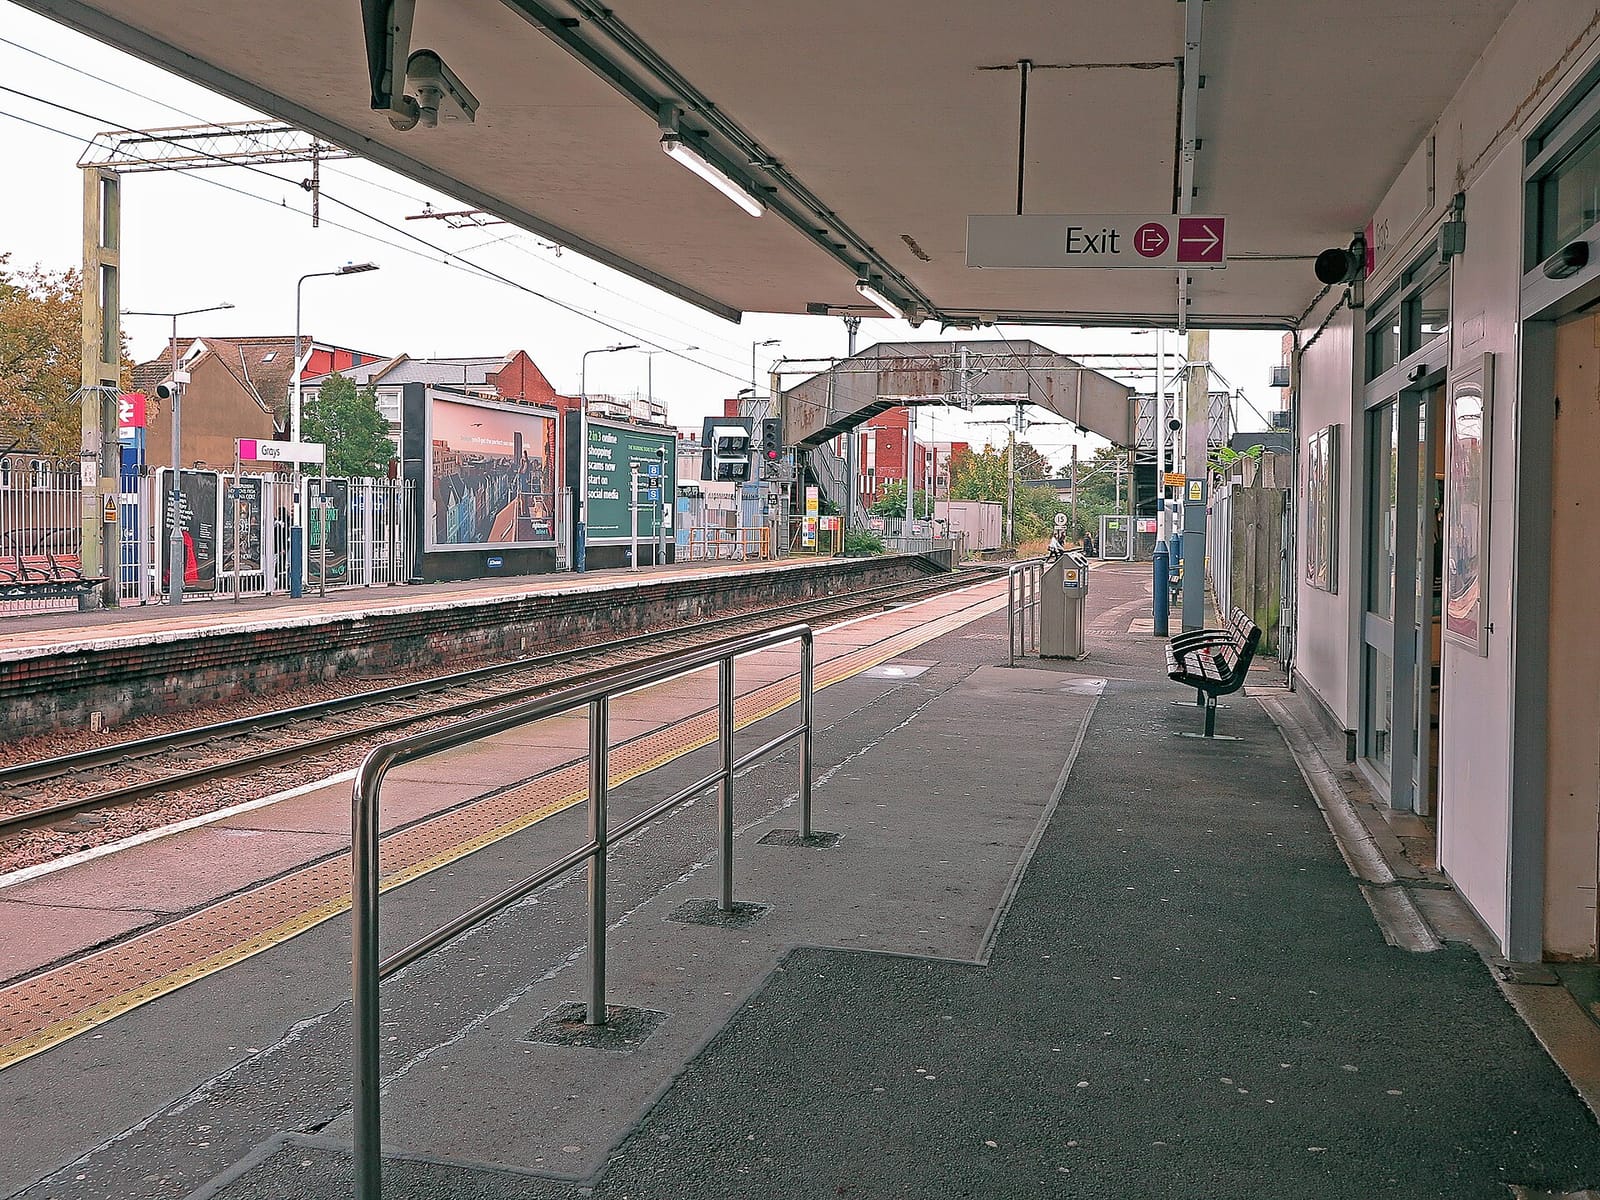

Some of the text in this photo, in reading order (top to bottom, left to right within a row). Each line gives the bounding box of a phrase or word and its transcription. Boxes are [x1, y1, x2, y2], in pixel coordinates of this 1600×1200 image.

[1066, 226, 1120, 254] Exit
[588, 430, 618, 444] 2 in 3 online
[261, 444, 280, 458] Grays
[588, 444, 612, 460] shopping
[588, 461, 616, 472] scams now
[651, 466, 657, 474] 8
[588, 474, 608, 485] start on
[651, 478, 657, 486] 5
[588, 487, 602, 499] social
[603, 488, 619, 500] media
